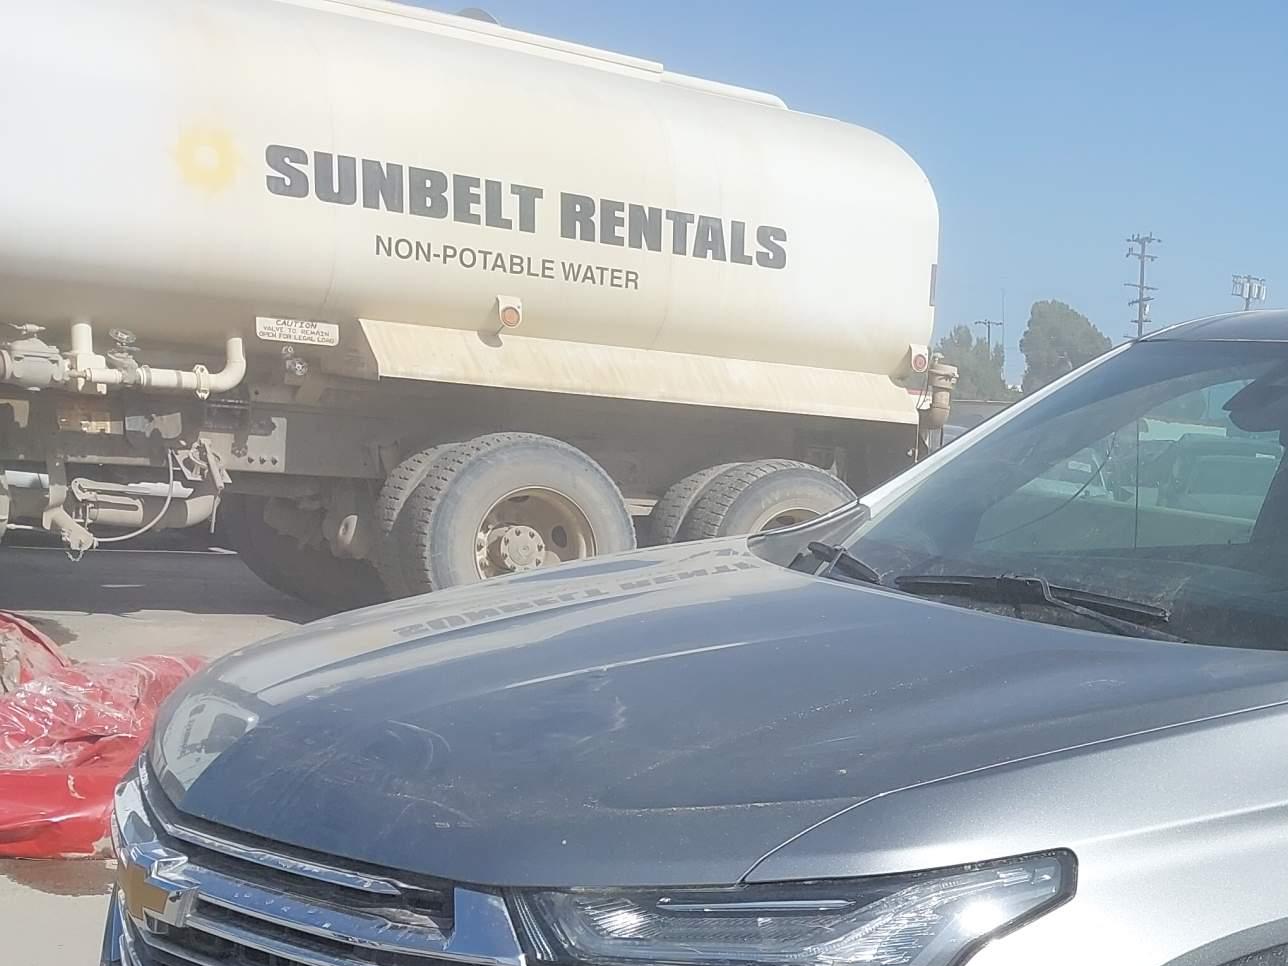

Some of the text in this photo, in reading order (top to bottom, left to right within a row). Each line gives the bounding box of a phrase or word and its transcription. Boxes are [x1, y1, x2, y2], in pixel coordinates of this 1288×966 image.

[265, 143, 788, 270] SUNBELT RENTALS
[375, 234, 640, 291] NON-POTABLE WATER
[276, 320, 317, 329] CAUTION
[278, 332, 292, 340] FOR
[301, 329, 330, 337] REMAIN
